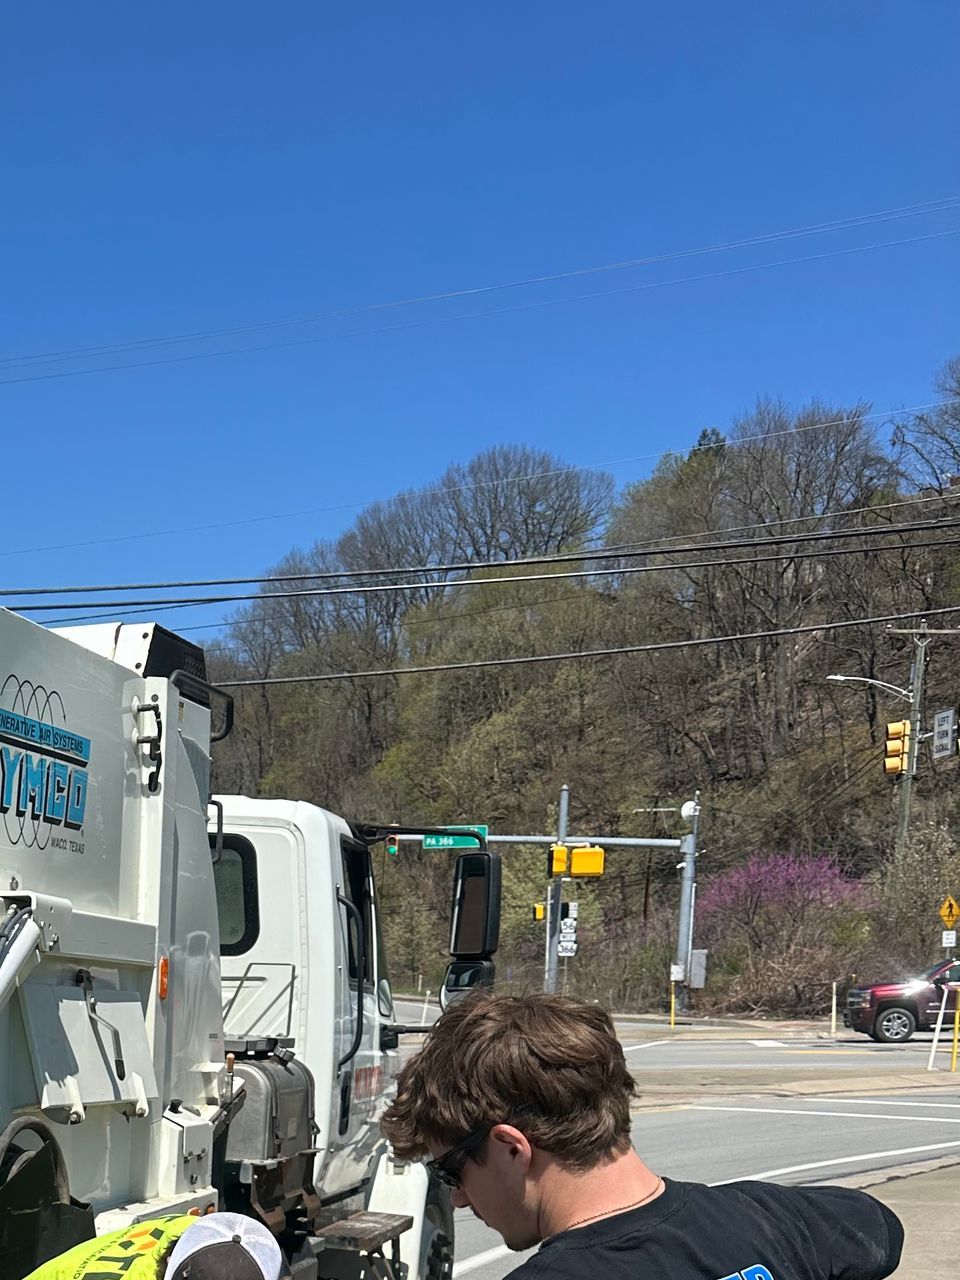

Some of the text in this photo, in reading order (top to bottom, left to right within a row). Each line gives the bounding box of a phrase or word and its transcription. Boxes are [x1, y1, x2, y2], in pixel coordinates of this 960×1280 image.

[39, 727, 52, 743] AIR
[54, 732, 83, 754] SYSTEMS
[69, 839, 85, 854] TEXAS
